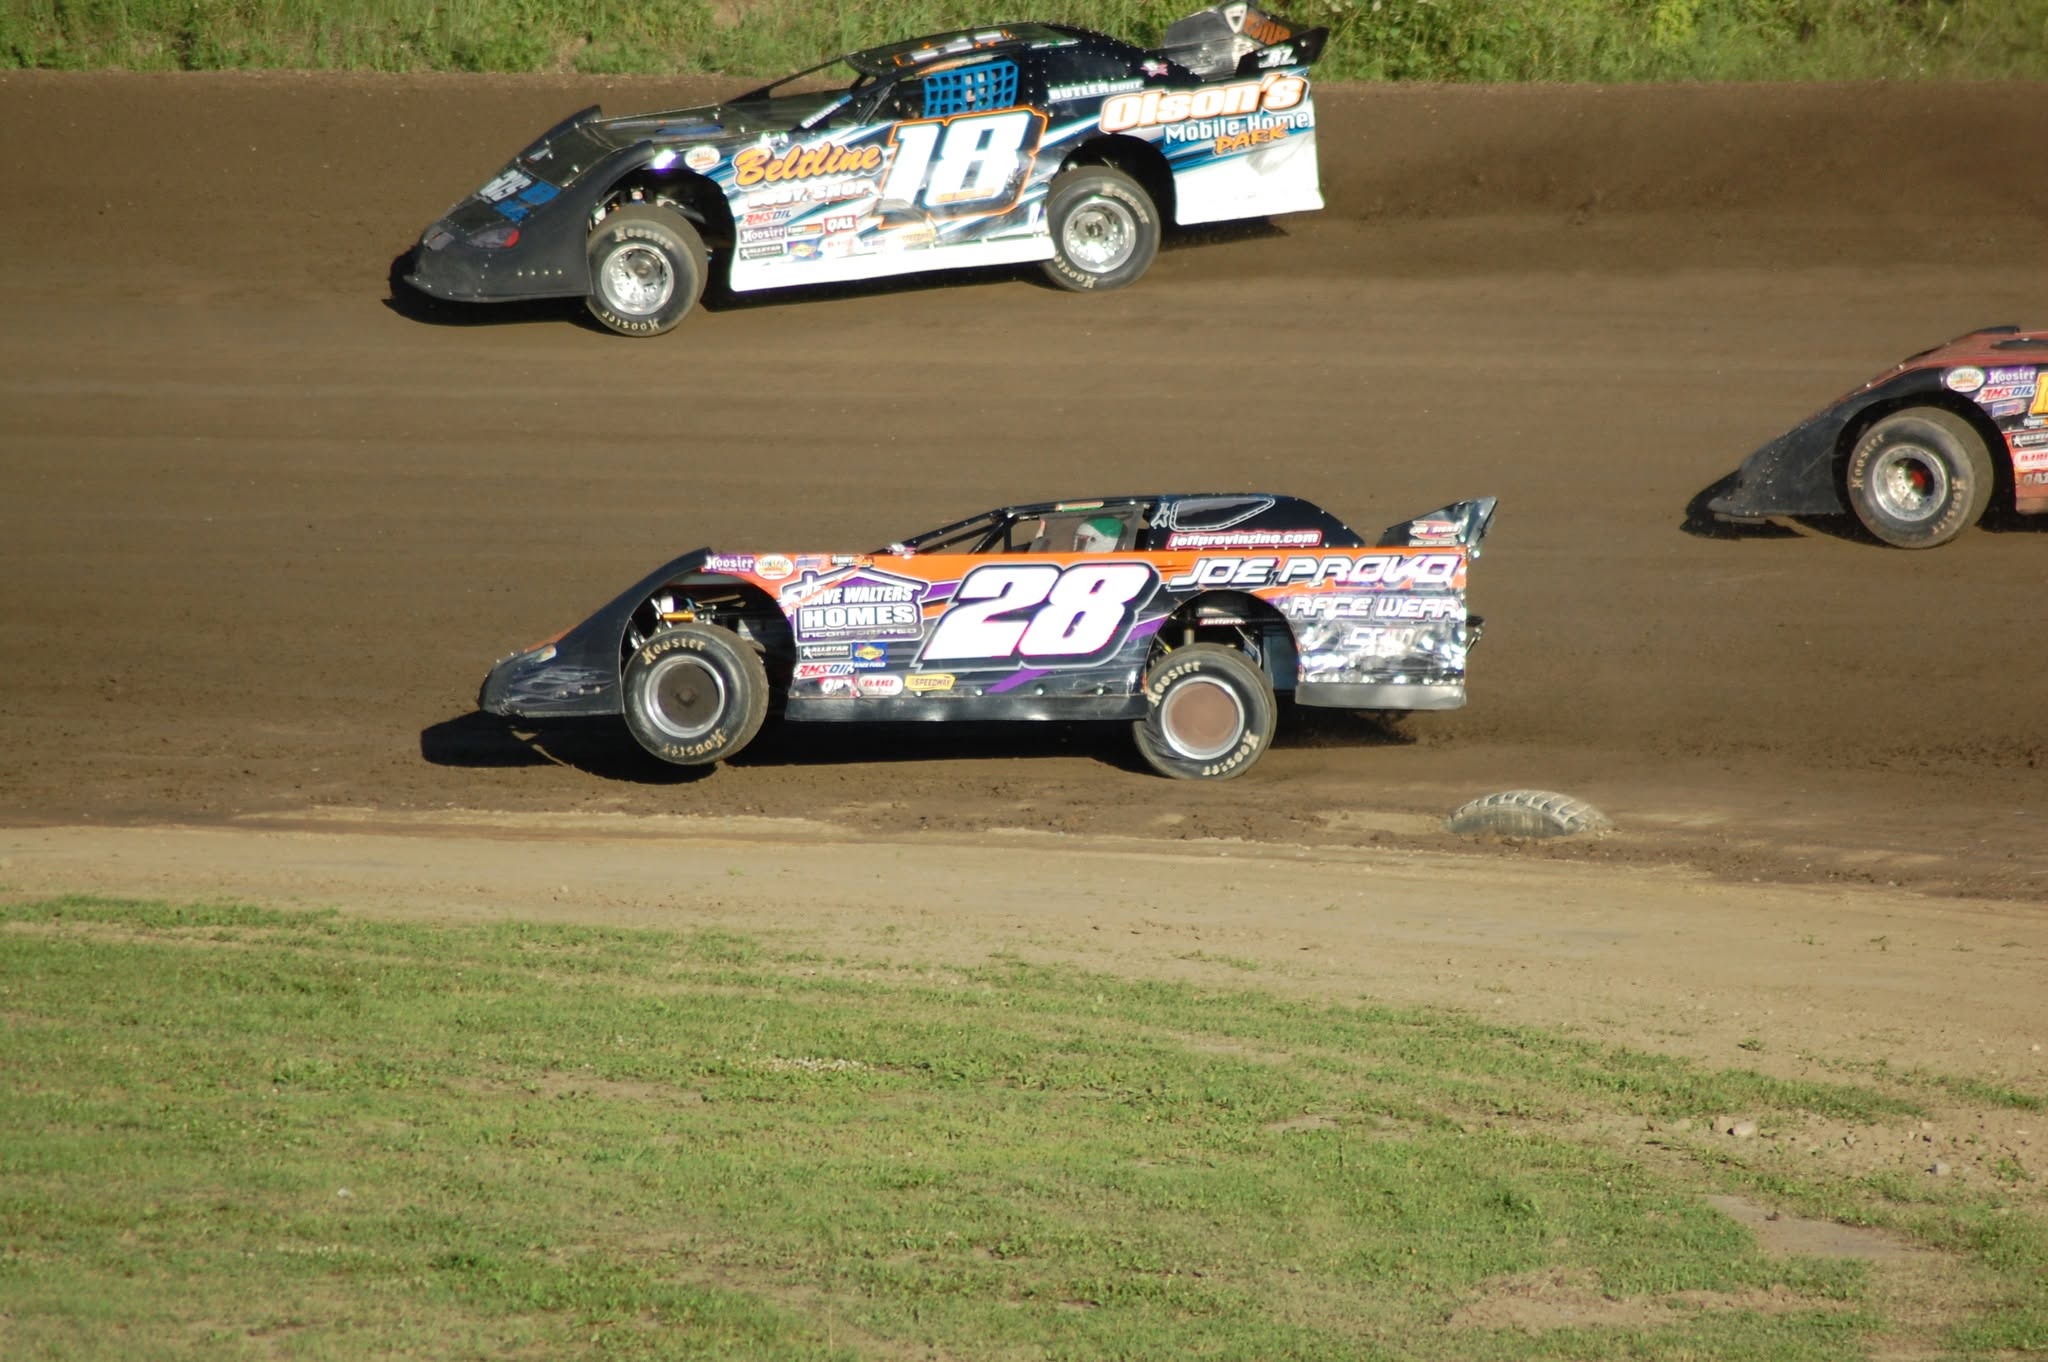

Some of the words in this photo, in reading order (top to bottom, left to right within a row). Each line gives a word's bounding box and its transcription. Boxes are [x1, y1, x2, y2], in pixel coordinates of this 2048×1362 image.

[1101, 72, 1309, 133] Olson's
[1165, 117, 1239, 145] Mobile
[1241, 112, 1311, 136] Home
[1214, 124, 1288, 154] PARK
[734, 143, 883, 187] Beltline
[884, 110, 1034, 208] 18
[743, 209, 792, 226] AMSOIL
[741, 228, 784, 243] Hoosier
[1054, 252, 1098, 288] Hoosie
[602, 310, 660, 332] Hoosier
[1987, 368, 2036, 384] Hoosier
[1982, 384, 2034, 399] AMSOIL
[1851, 432, 1885, 490] Hoosier
[704, 555, 754, 569] Hoosier
[1168, 556, 1278, 588] JOE
[1277, 554, 1462, 587] PROVO
[844, 585, 913, 603] WALTERS
[1376, 596, 1464, 620] WEAR
[803, 605, 915, 629] HOMES
[921, 563, 1152, 661] 28
[640, 637, 707, 665] Hoosier
[1147, 661, 1201, 708] Hoosier
[663, 728, 728, 757] Hoosier
[1202, 729, 1260, 776] Hoosier
